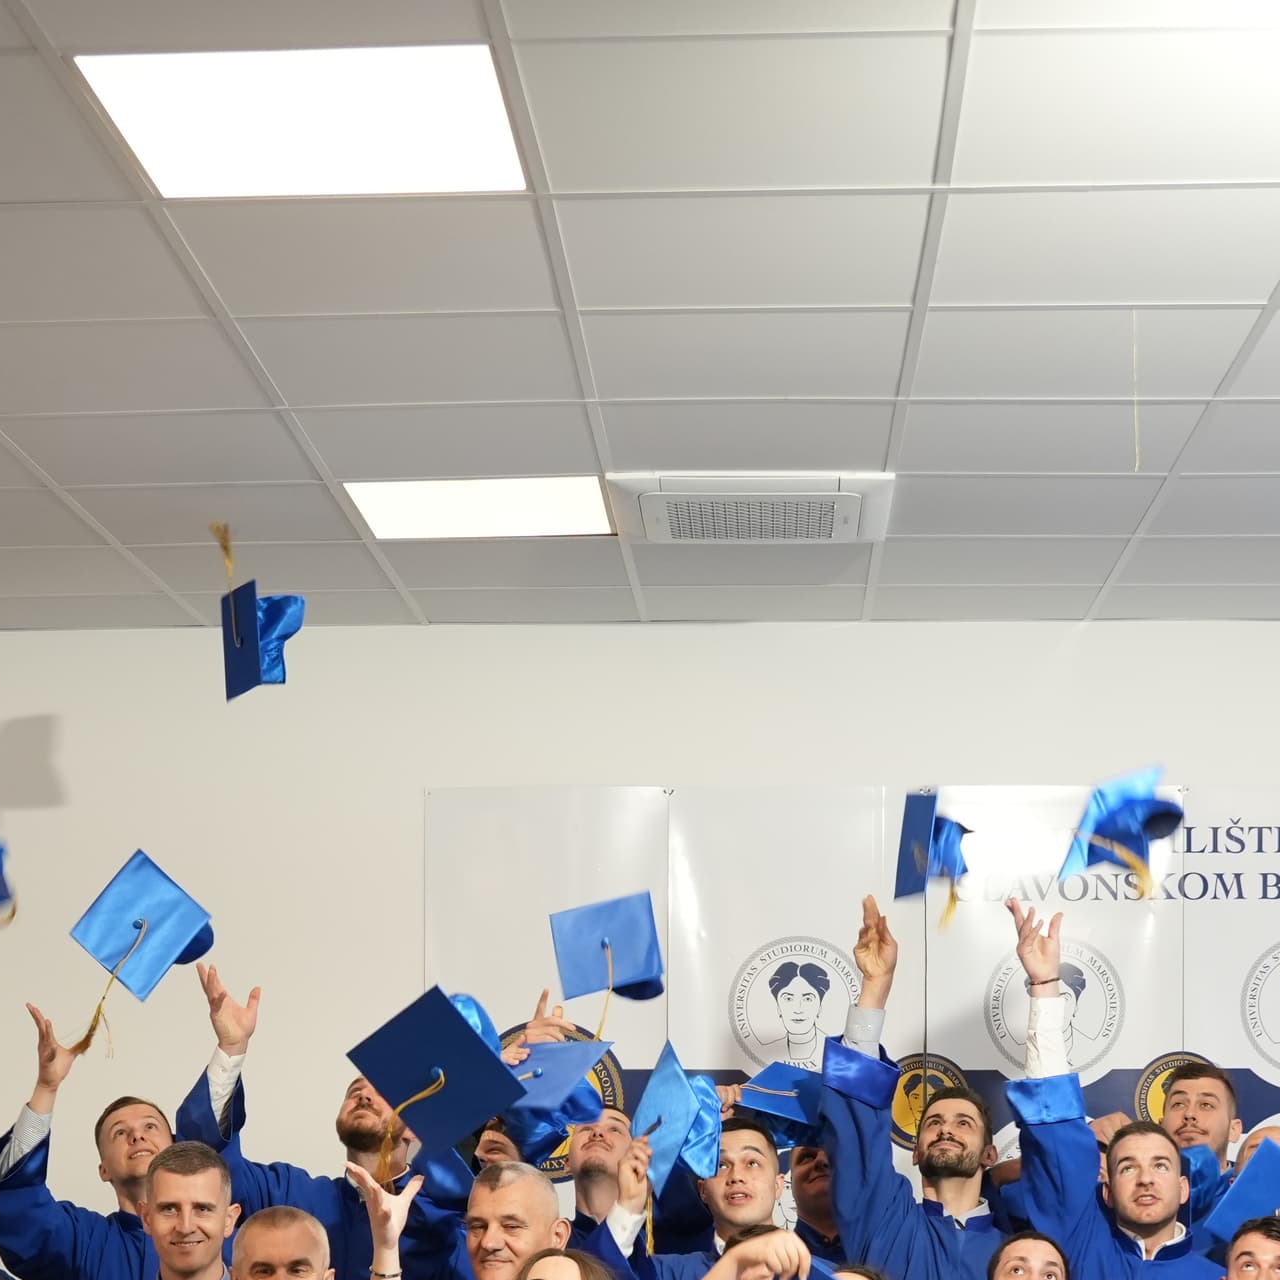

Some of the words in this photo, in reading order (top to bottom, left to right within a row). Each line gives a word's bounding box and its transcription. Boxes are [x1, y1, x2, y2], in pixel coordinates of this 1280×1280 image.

[735, 965, 758, 1039] UNIVERSITAS
[760, 944, 828, 964] STUDIORUM
[831, 957, 861, 1001] MARSON
[991, 966, 1013, 1040] UNIVERSITAS
[1087, 956, 1118, 1039] MARSONIENSIS
[1247, 964, 1270, 1038] UNIVERSITAS
